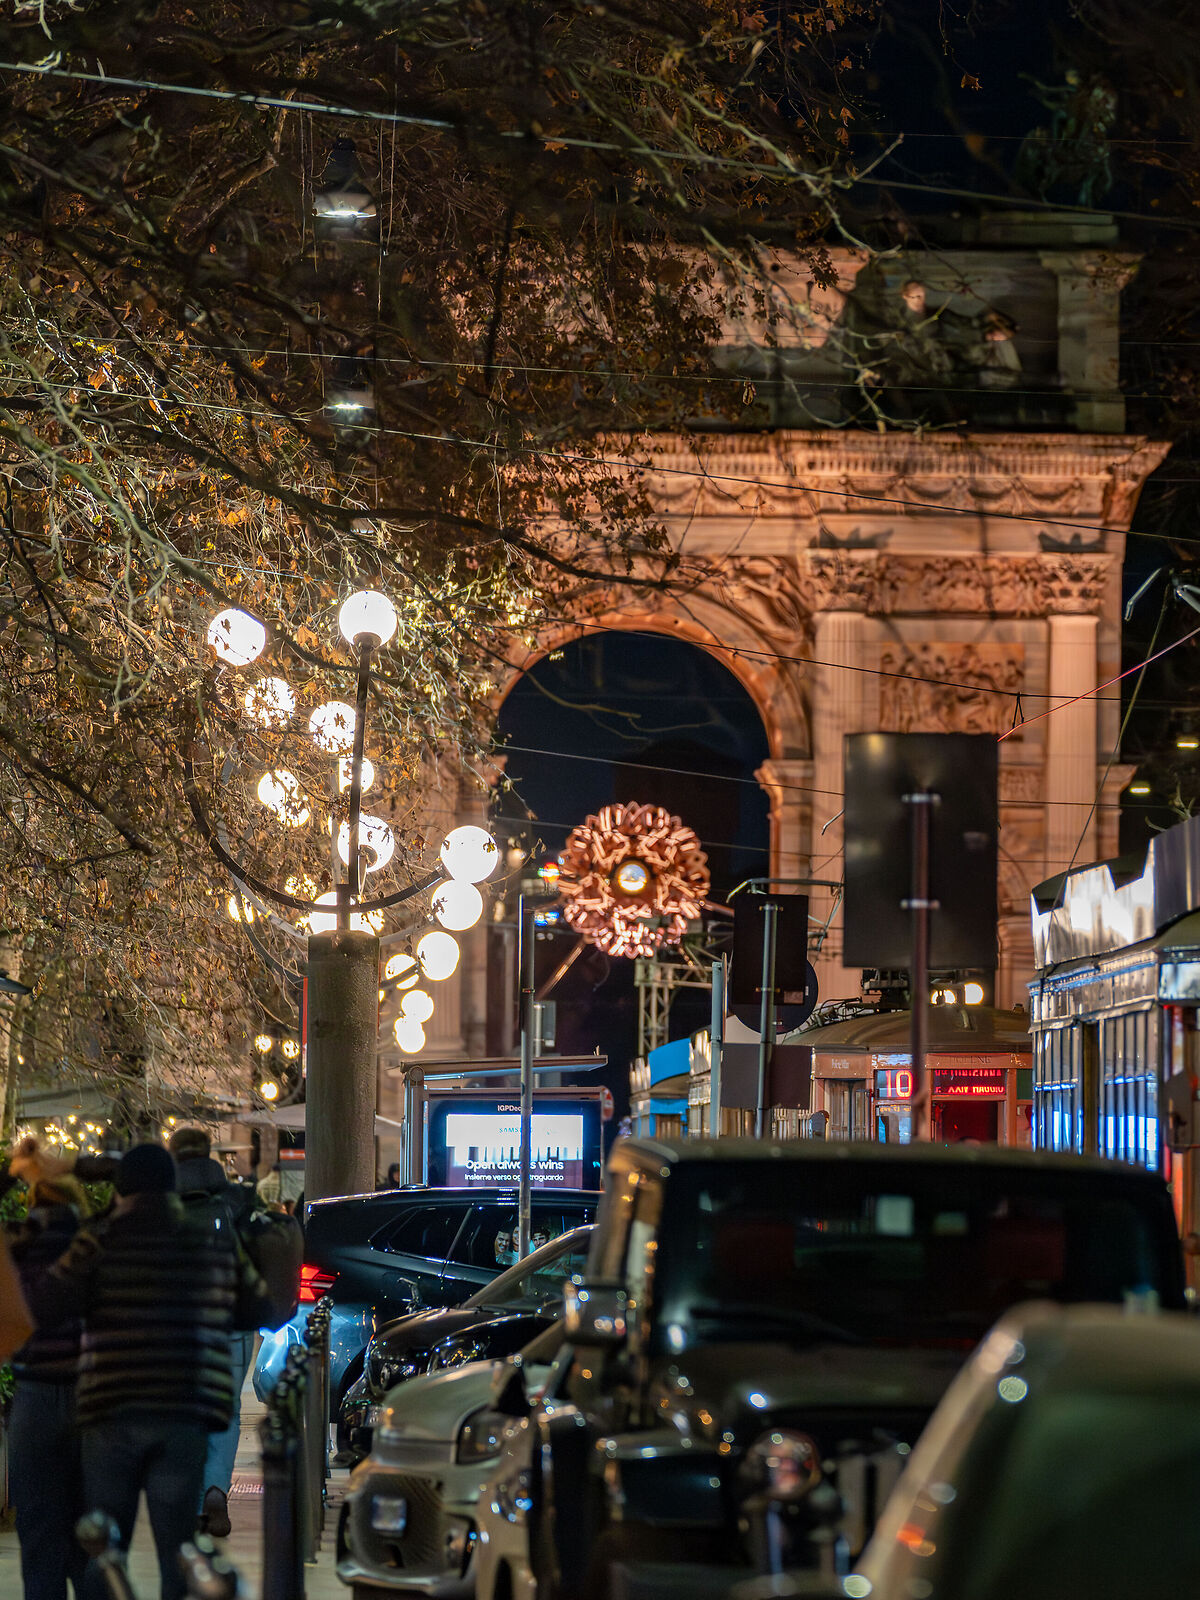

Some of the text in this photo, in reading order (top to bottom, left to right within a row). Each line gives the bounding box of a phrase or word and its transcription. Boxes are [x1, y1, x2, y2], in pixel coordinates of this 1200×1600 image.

[886, 1070, 913, 1098] 10
[465, 1159, 564, 1172] Open alwas wins
[464, 1173, 492, 1181] Insieme
